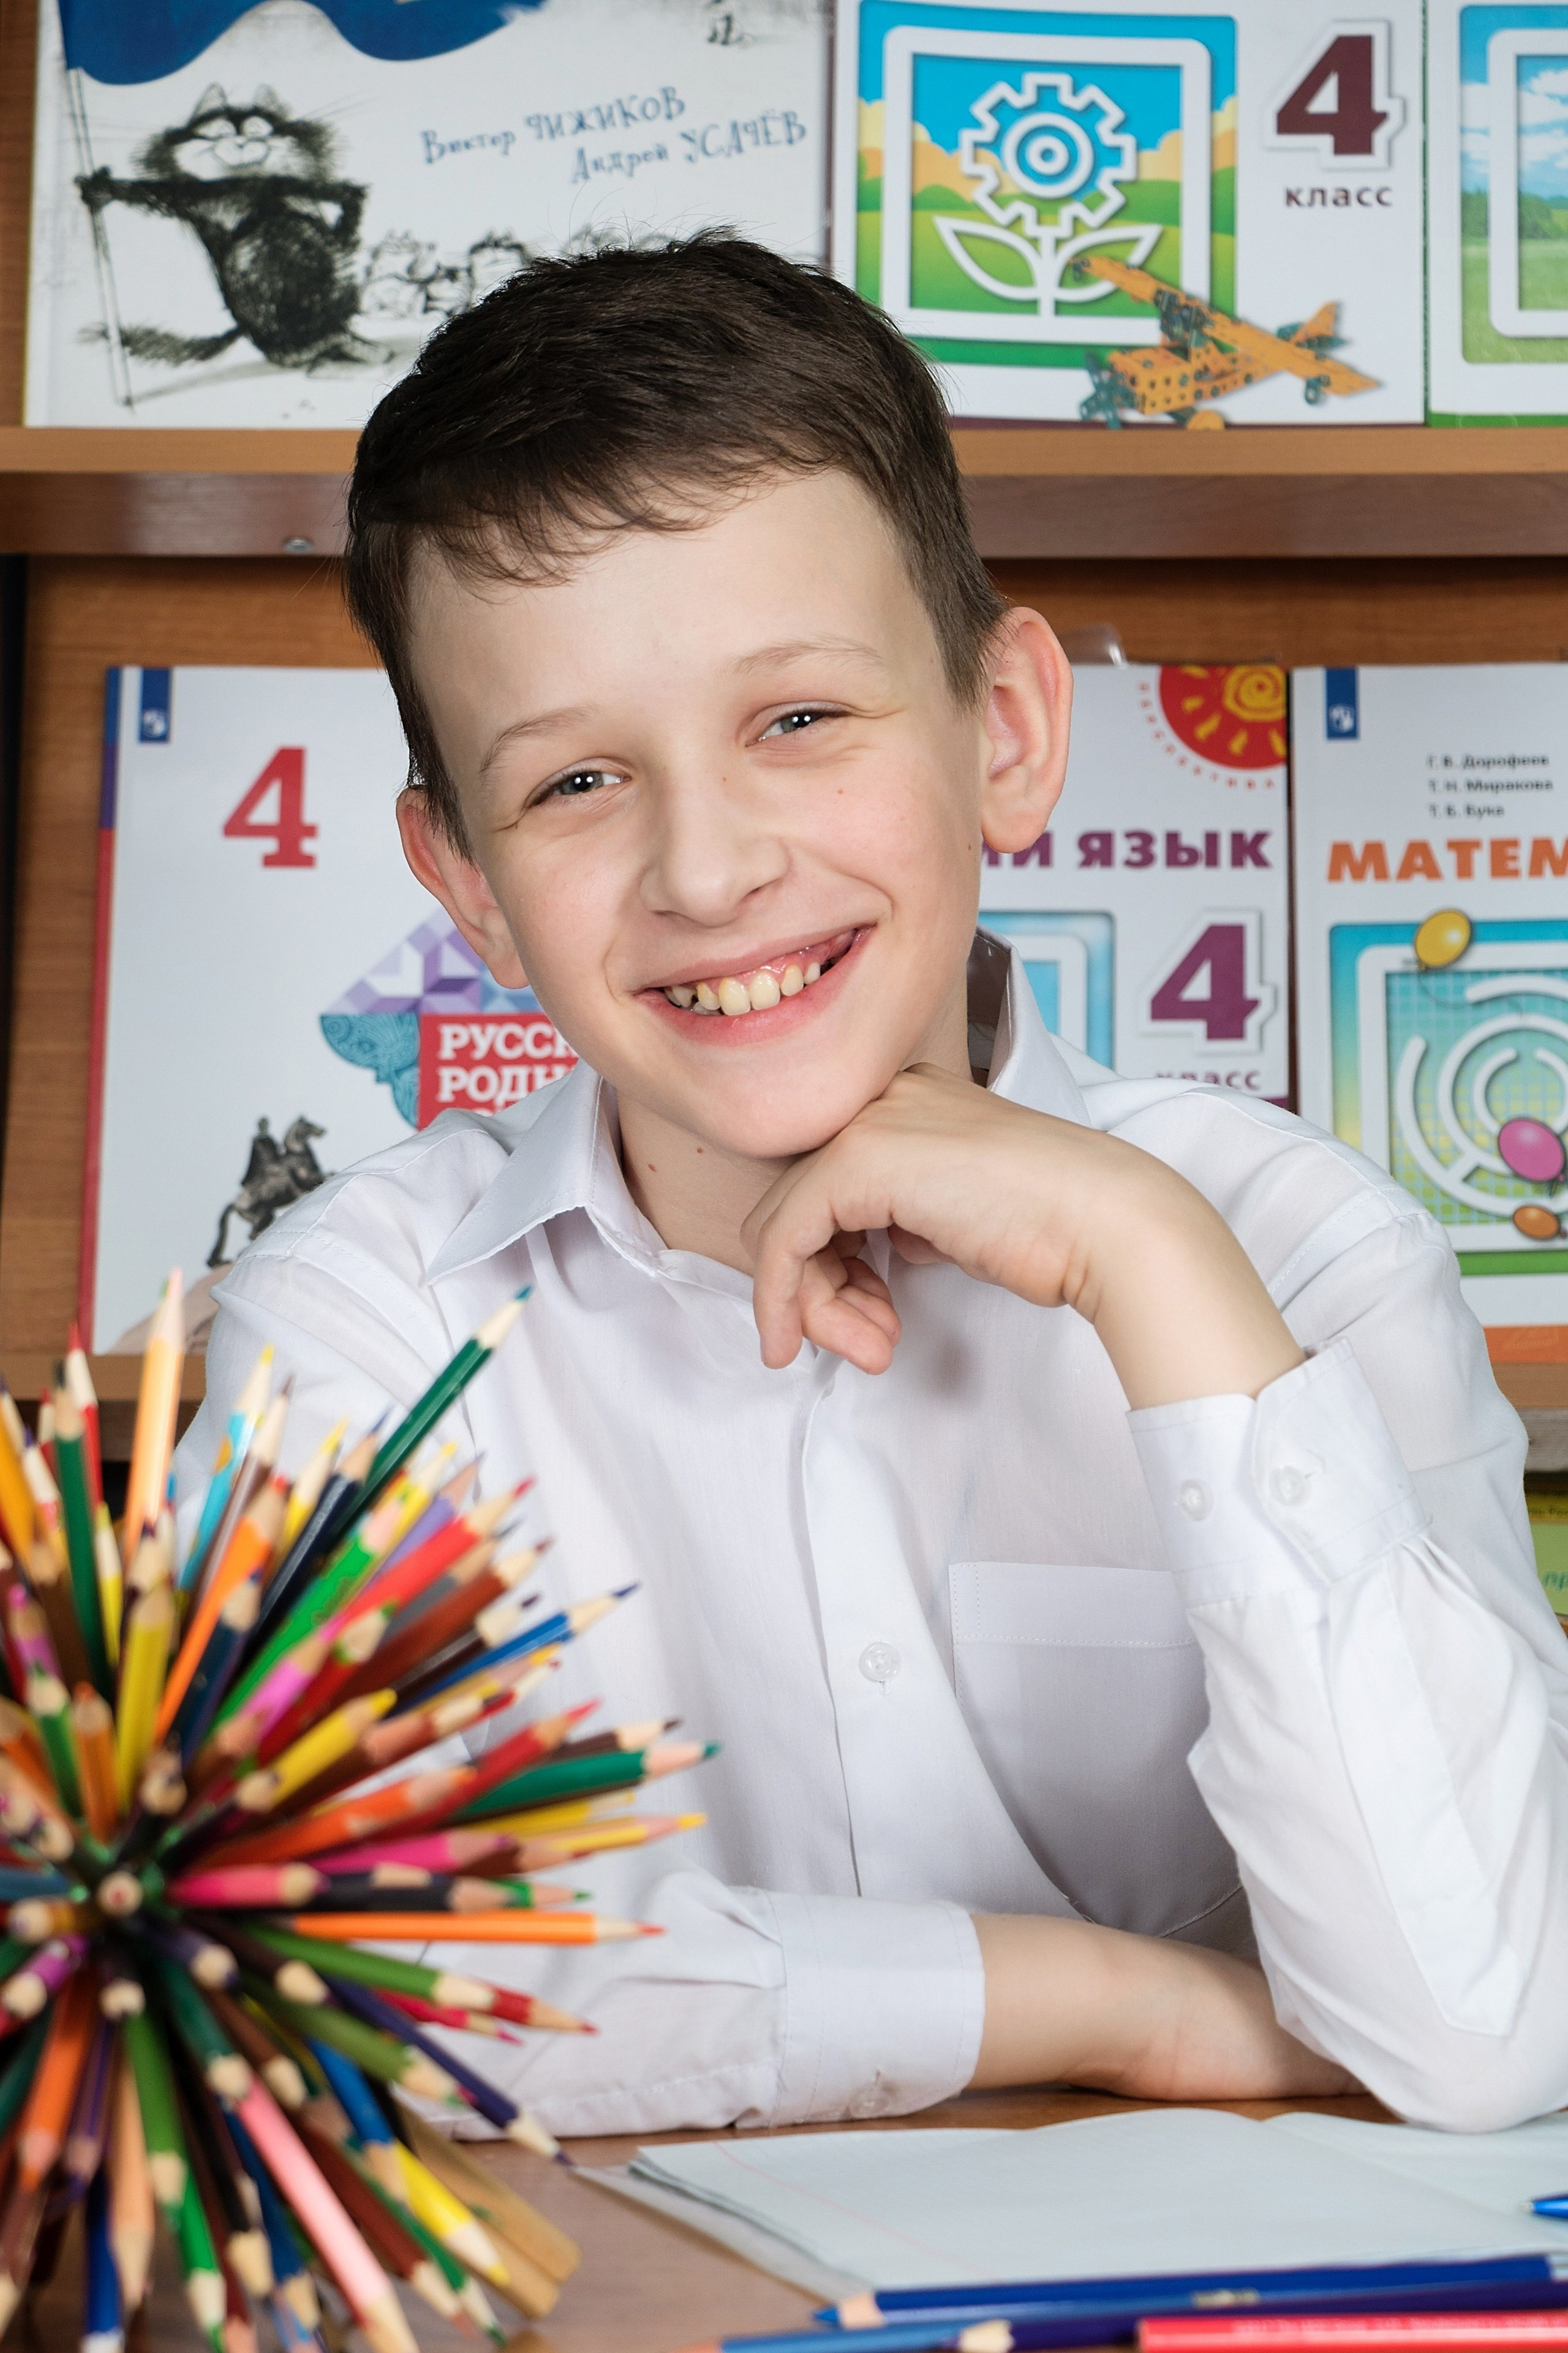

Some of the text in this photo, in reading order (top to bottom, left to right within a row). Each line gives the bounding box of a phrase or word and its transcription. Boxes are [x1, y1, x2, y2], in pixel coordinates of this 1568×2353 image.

[1276, 34, 1389, 155] 4
[420, 86, 686, 164] Виктор ЧИЖИКОВ
[572, 108, 807, 183] Андрей УСАЧЁВ
[1285, 186, 1393, 207] класс
[1463, 754, 1550, 770] Дорофеев
[222, 746, 318, 868] 4
[1466, 779, 1553, 795] Миракова
[1077, 829, 1273, 869] ЯЗЫК
[1327, 837, 1568, 882] МАТЕМ
[1150, 923, 1261, 1041] 4
[1156, 1071, 1261, 1090] асс
